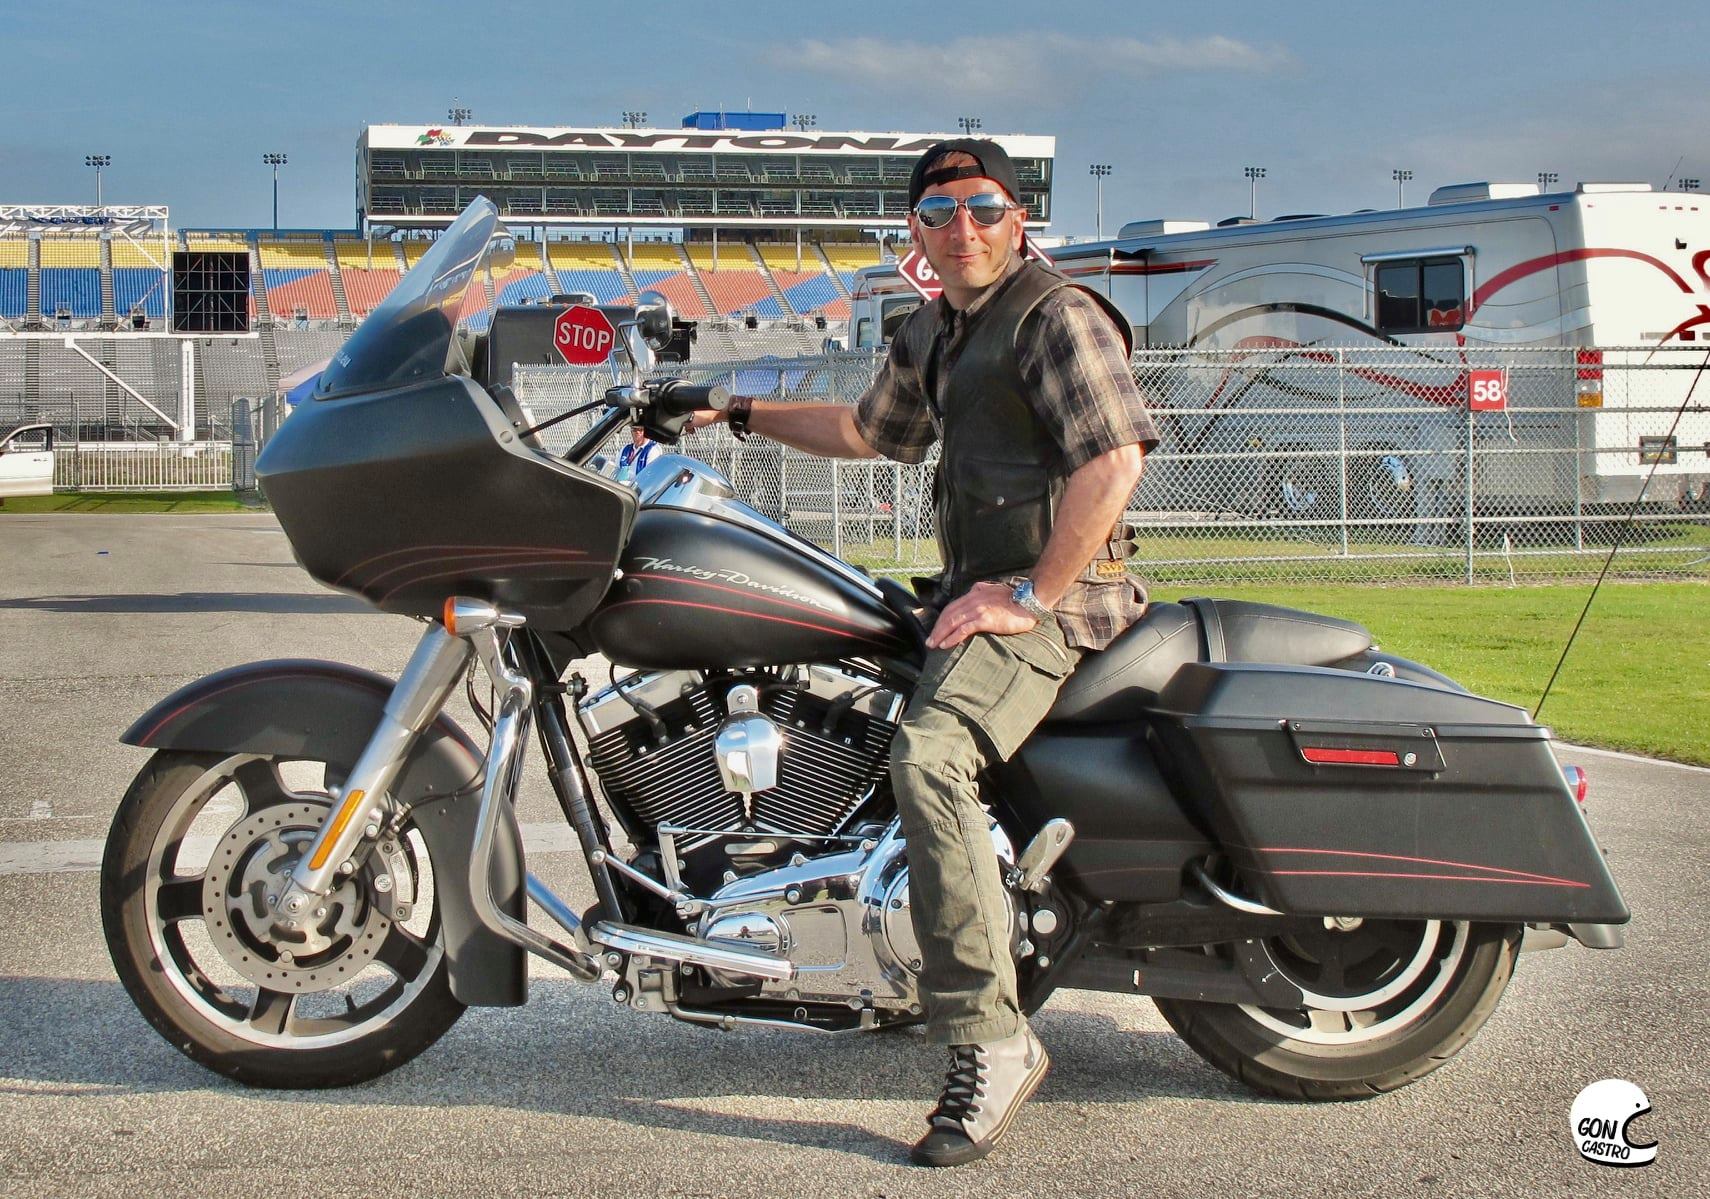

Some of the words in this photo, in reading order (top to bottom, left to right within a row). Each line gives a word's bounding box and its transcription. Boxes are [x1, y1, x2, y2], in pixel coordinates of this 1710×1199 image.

[558, 321, 611, 352] STOP
[1473, 379, 1502, 402] 58
[633, 556, 833, 612] Harley-Davidson
